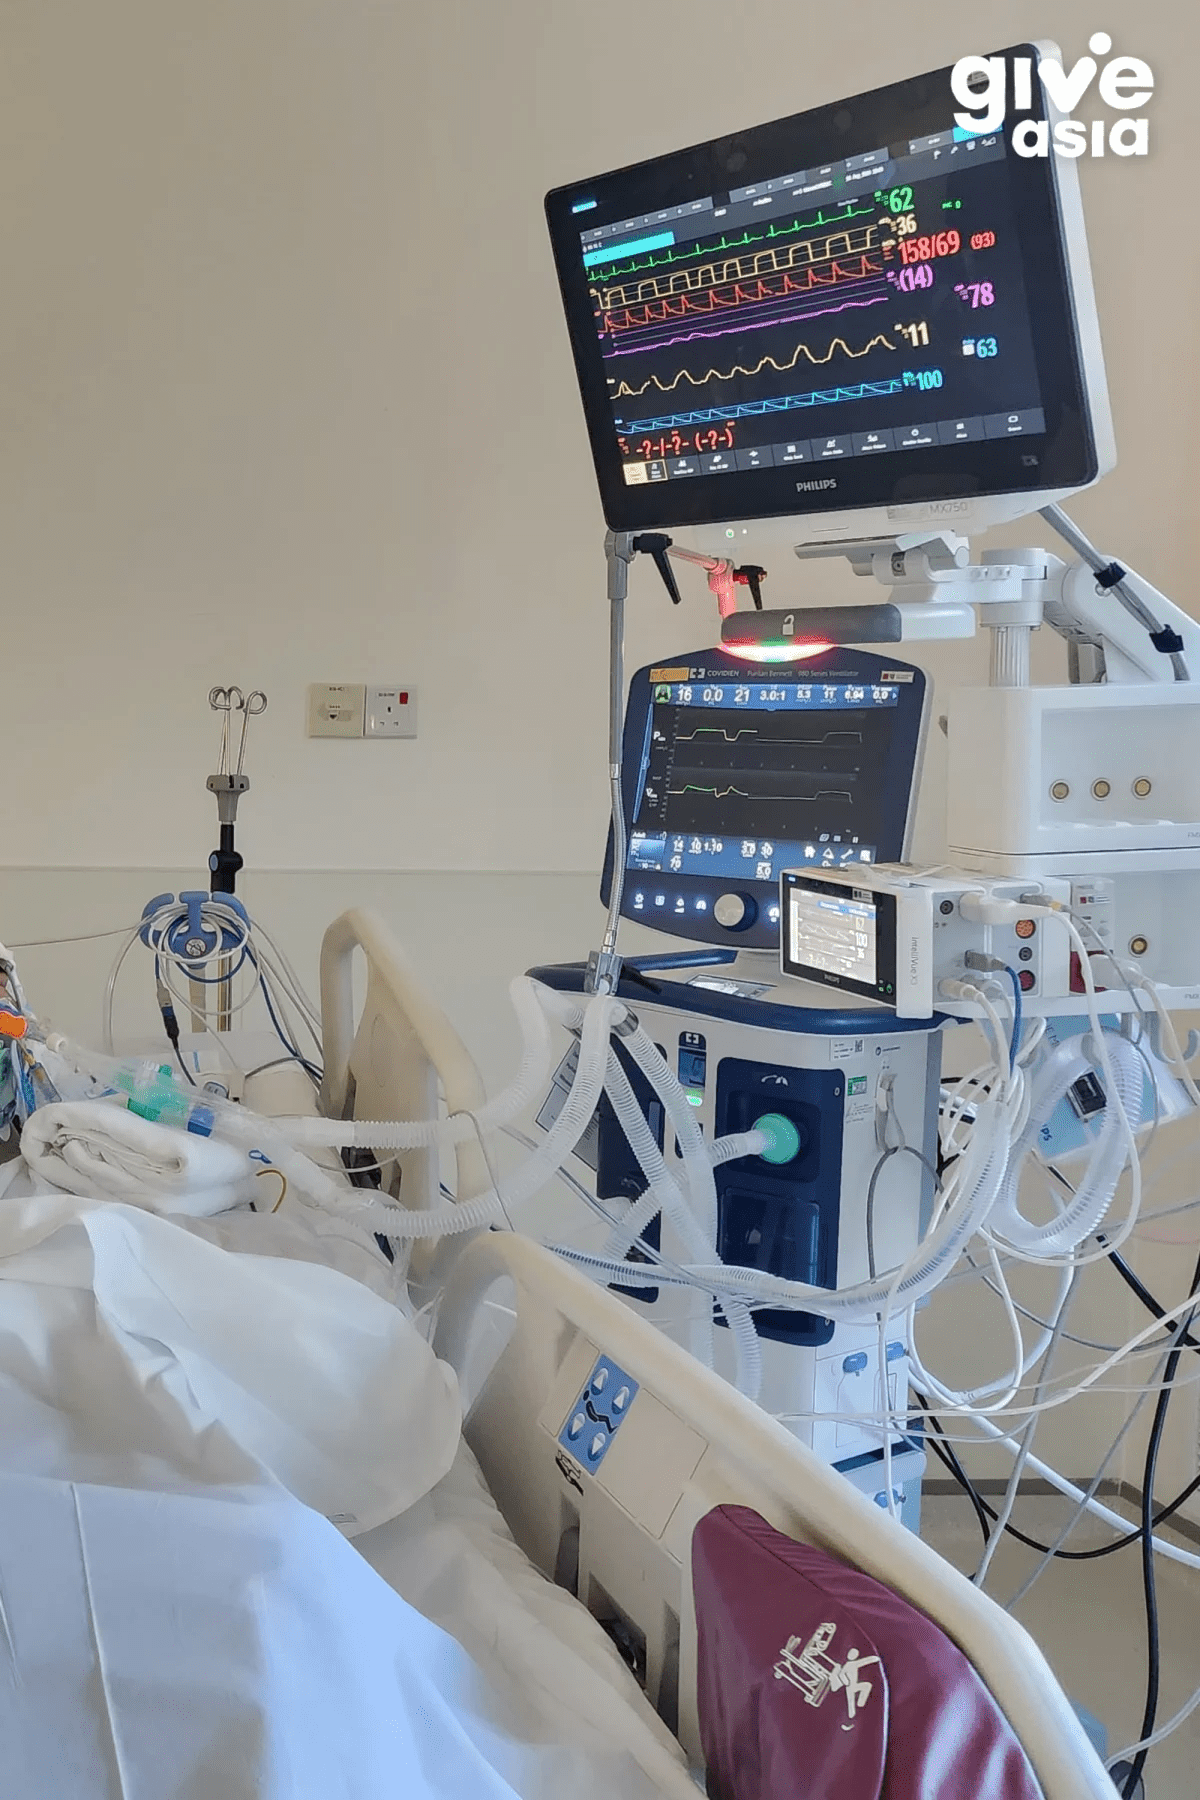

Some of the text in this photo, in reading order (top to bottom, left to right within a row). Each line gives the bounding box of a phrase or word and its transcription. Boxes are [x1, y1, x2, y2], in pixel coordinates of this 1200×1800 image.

[889, 187, 915, 213] 62
[897, 213, 917, 236] 36
[898, 230, 960, 264] 158/69
[899, 264, 933, 292] (14)
[967, 282, 995, 308] 78
[908, 321, 929, 347] 11
[976, 338, 997, 358] 63
[916, 370, 942, 390] 100
[796, 478, 837, 492] PHILIPS
[929, 502, 968, 516] MX750
[677, 688, 693, 702] 16
[703, 688, 724, 702] 0.0
[734, 688, 751, 702] 21
[872, 690, 889, 700] 0.0
